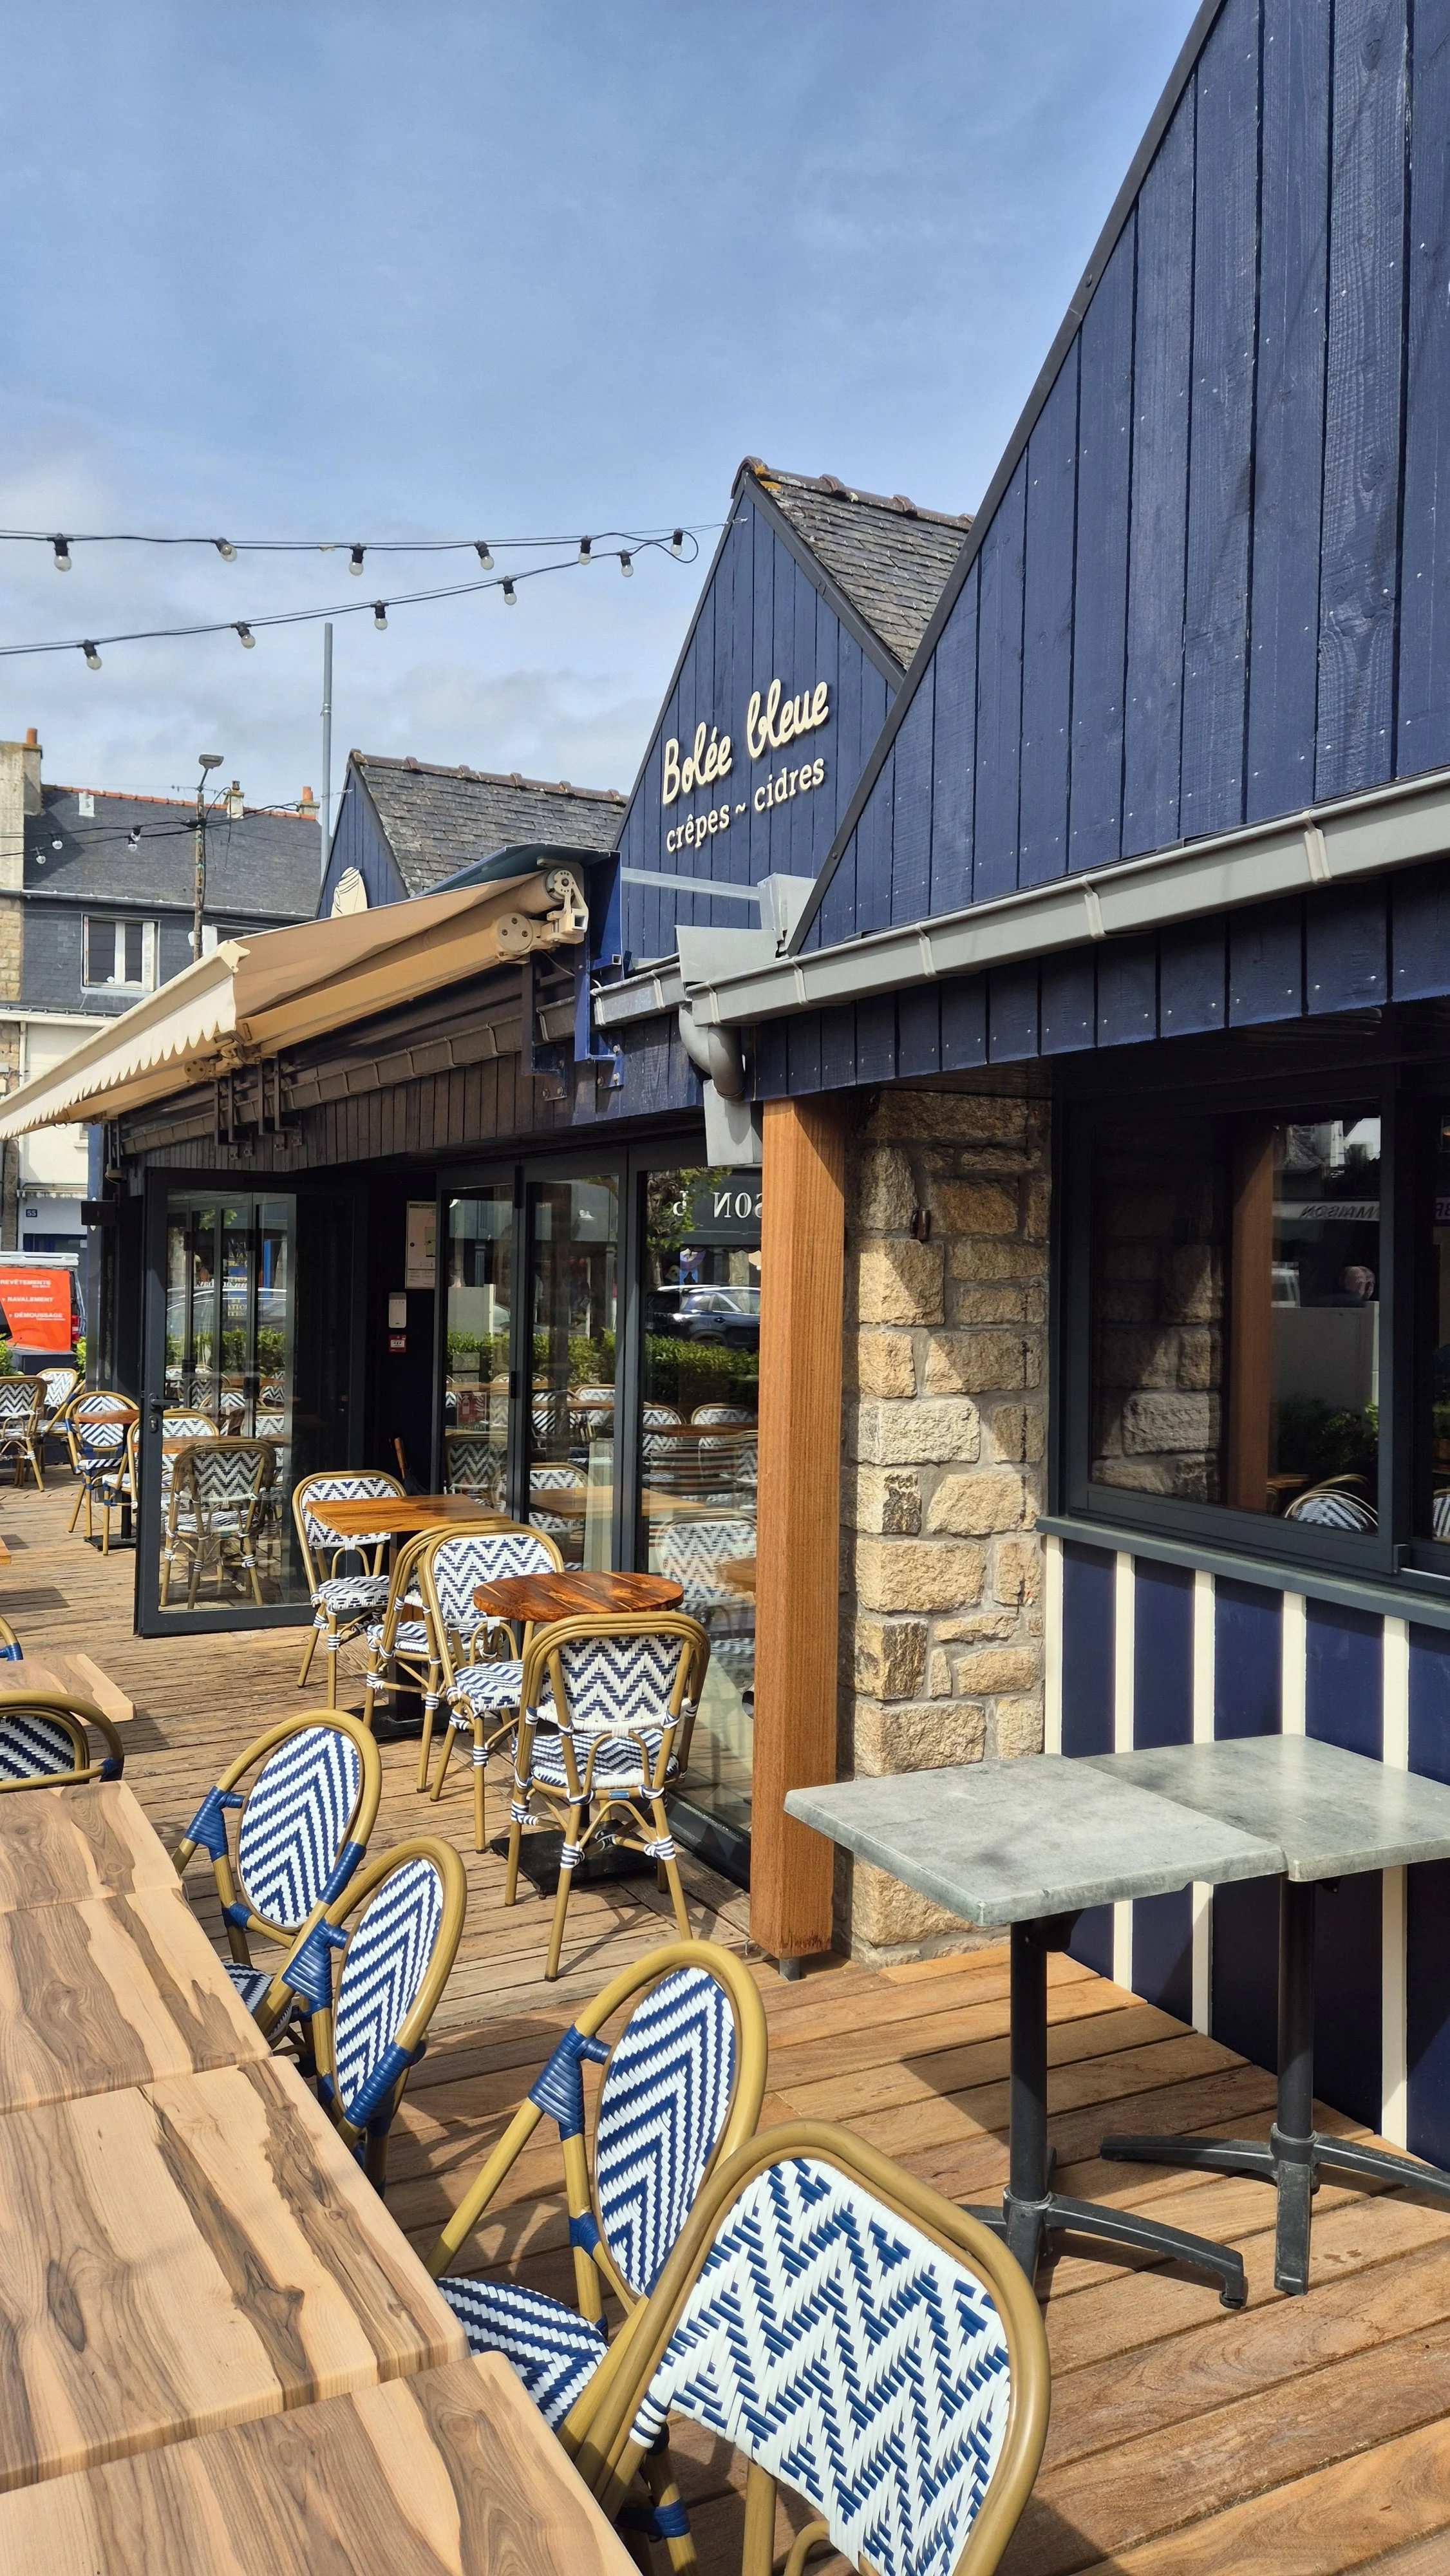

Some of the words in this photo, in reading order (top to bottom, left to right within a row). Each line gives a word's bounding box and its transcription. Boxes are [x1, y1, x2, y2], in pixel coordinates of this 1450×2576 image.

[663, 721, 733, 805] Bolée
[747, 678, 829, 759] bleue
[666, 804, 730, 852] crêpes
[754, 758, 825, 811] cidres
